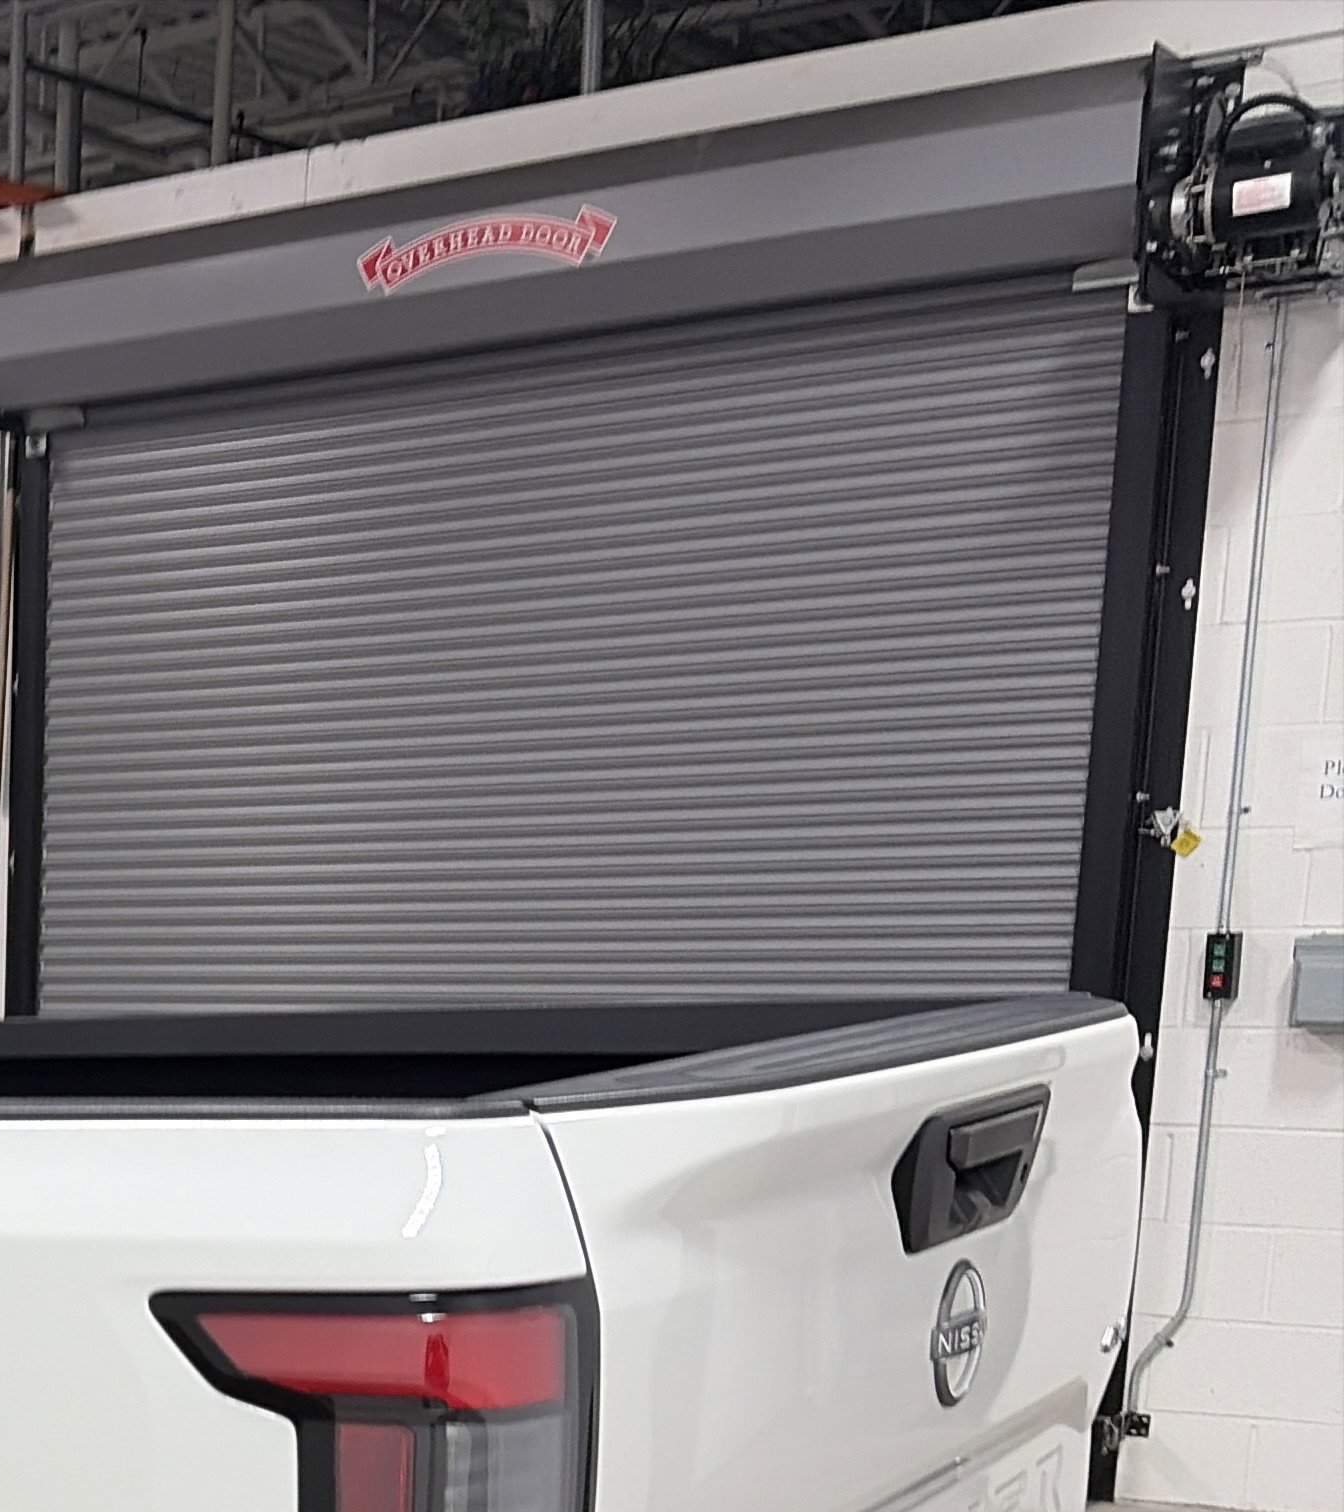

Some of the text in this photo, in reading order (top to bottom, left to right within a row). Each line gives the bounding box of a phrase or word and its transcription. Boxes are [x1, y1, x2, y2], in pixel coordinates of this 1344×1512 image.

[386, 222, 583, 280] OVERHEAD DOOR
[1324, 759, 1344, 776] Pl
[938, 1321, 983, 1356] NISS
